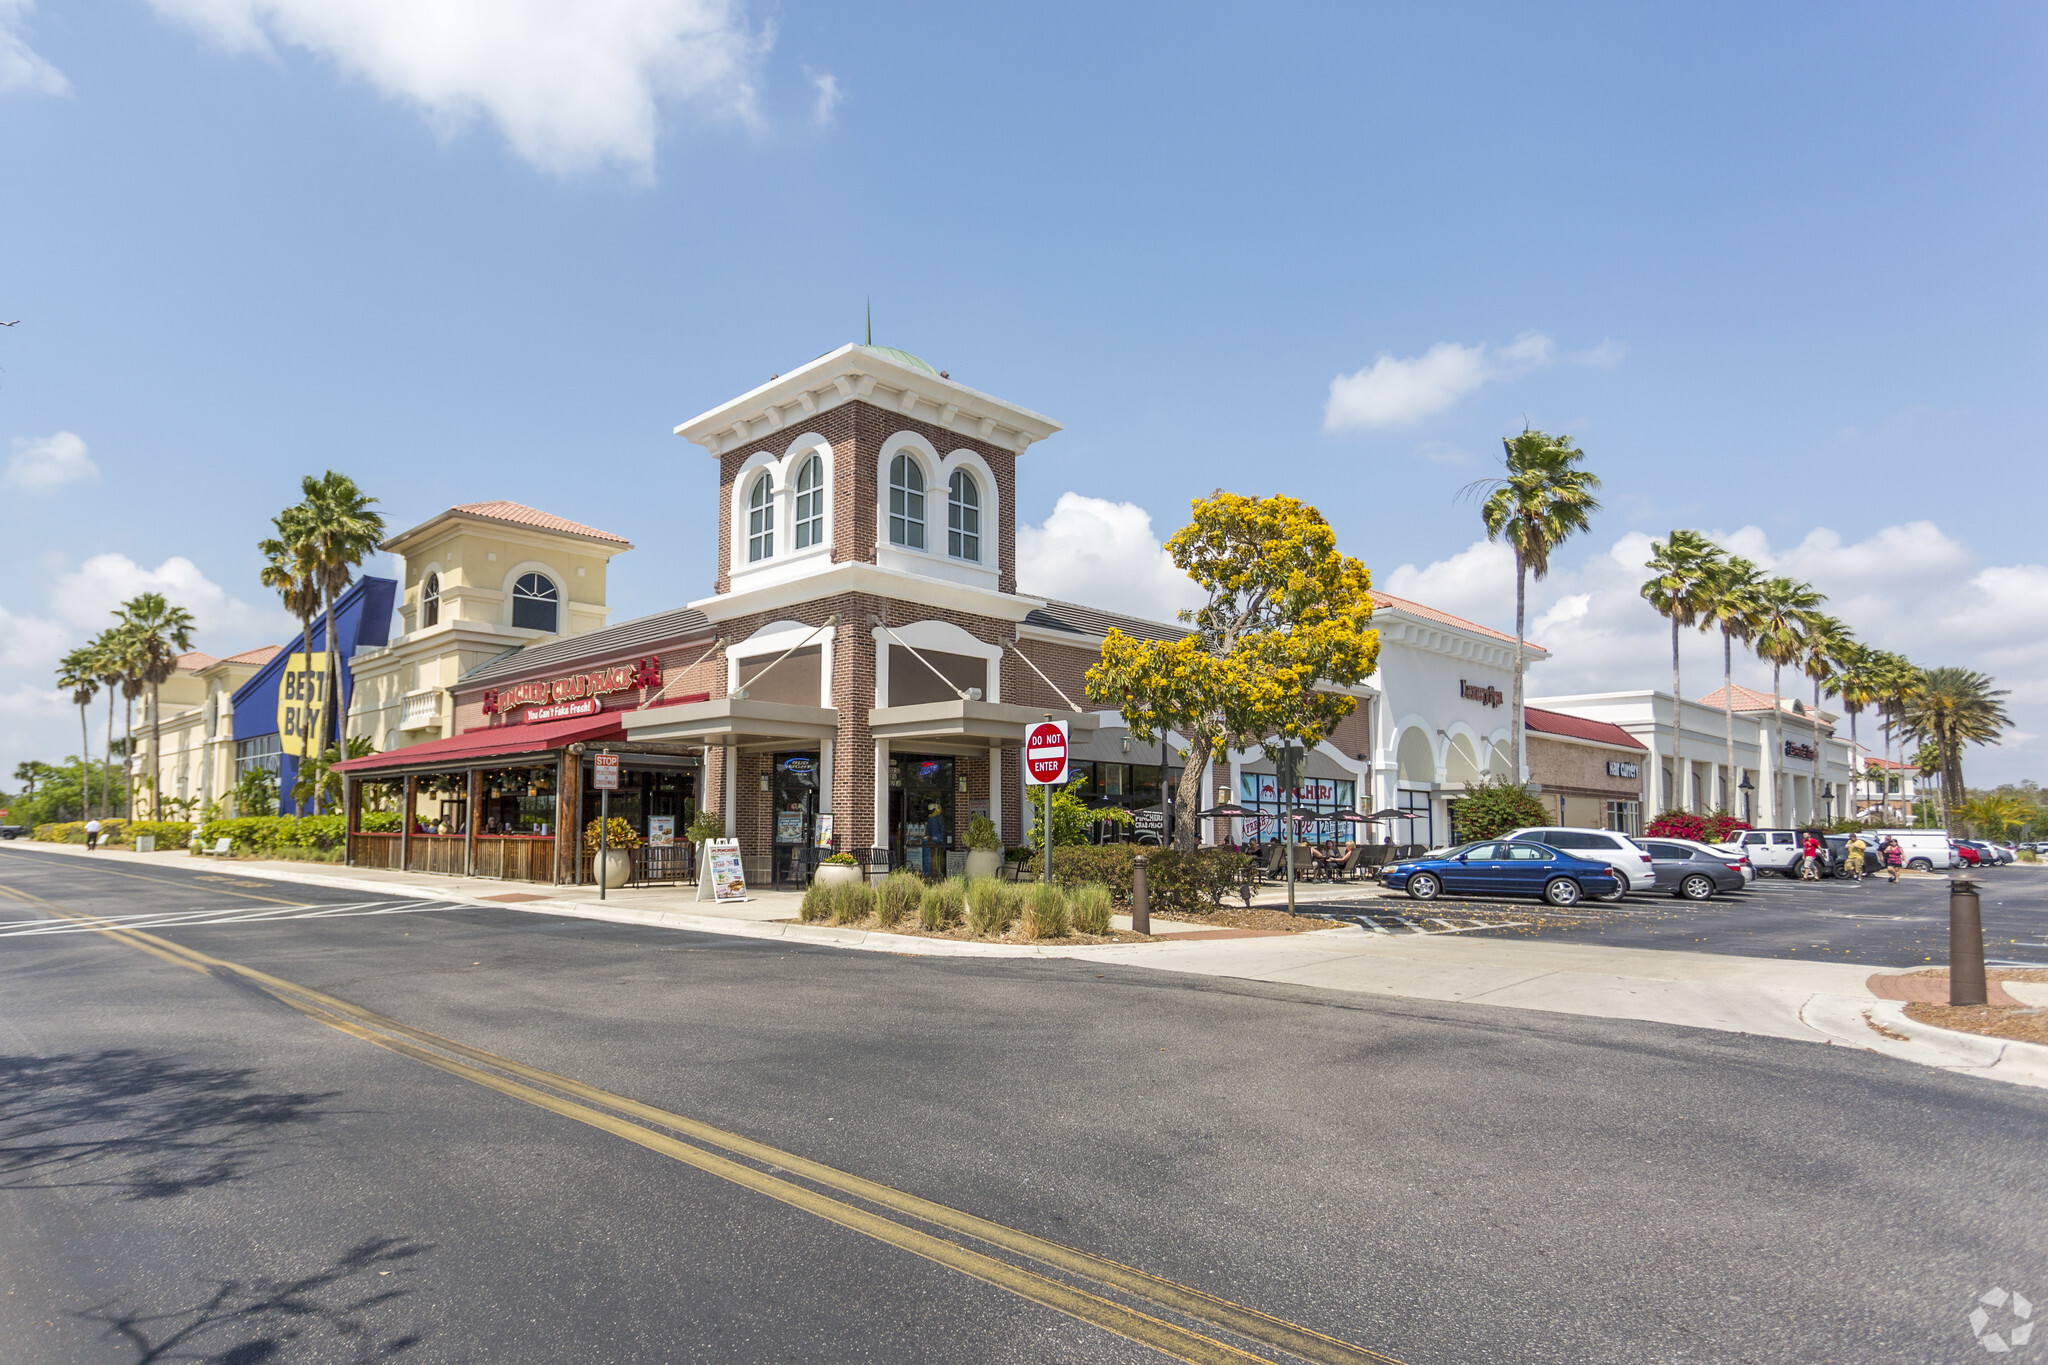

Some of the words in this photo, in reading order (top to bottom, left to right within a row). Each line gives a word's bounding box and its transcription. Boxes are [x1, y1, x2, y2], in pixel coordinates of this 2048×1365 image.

[498, 681, 551, 714] PINCHERS
[552, 674, 585, 701] CRAB
[587, 664, 633, 696] SHACK
[527, 710, 539, 721] You
[538, 707, 554, 719] Can't
[554, 705, 570, 716] Fake
[570, 702, 591, 714] Fresh!
[1032, 735, 1043, 746] DO
[1046, 733, 1062, 745] NOT
[596, 756, 617, 766] STOP
[1034, 760, 1059, 772] ENTER
[1280, 785, 1332, 801] PNCHERS
